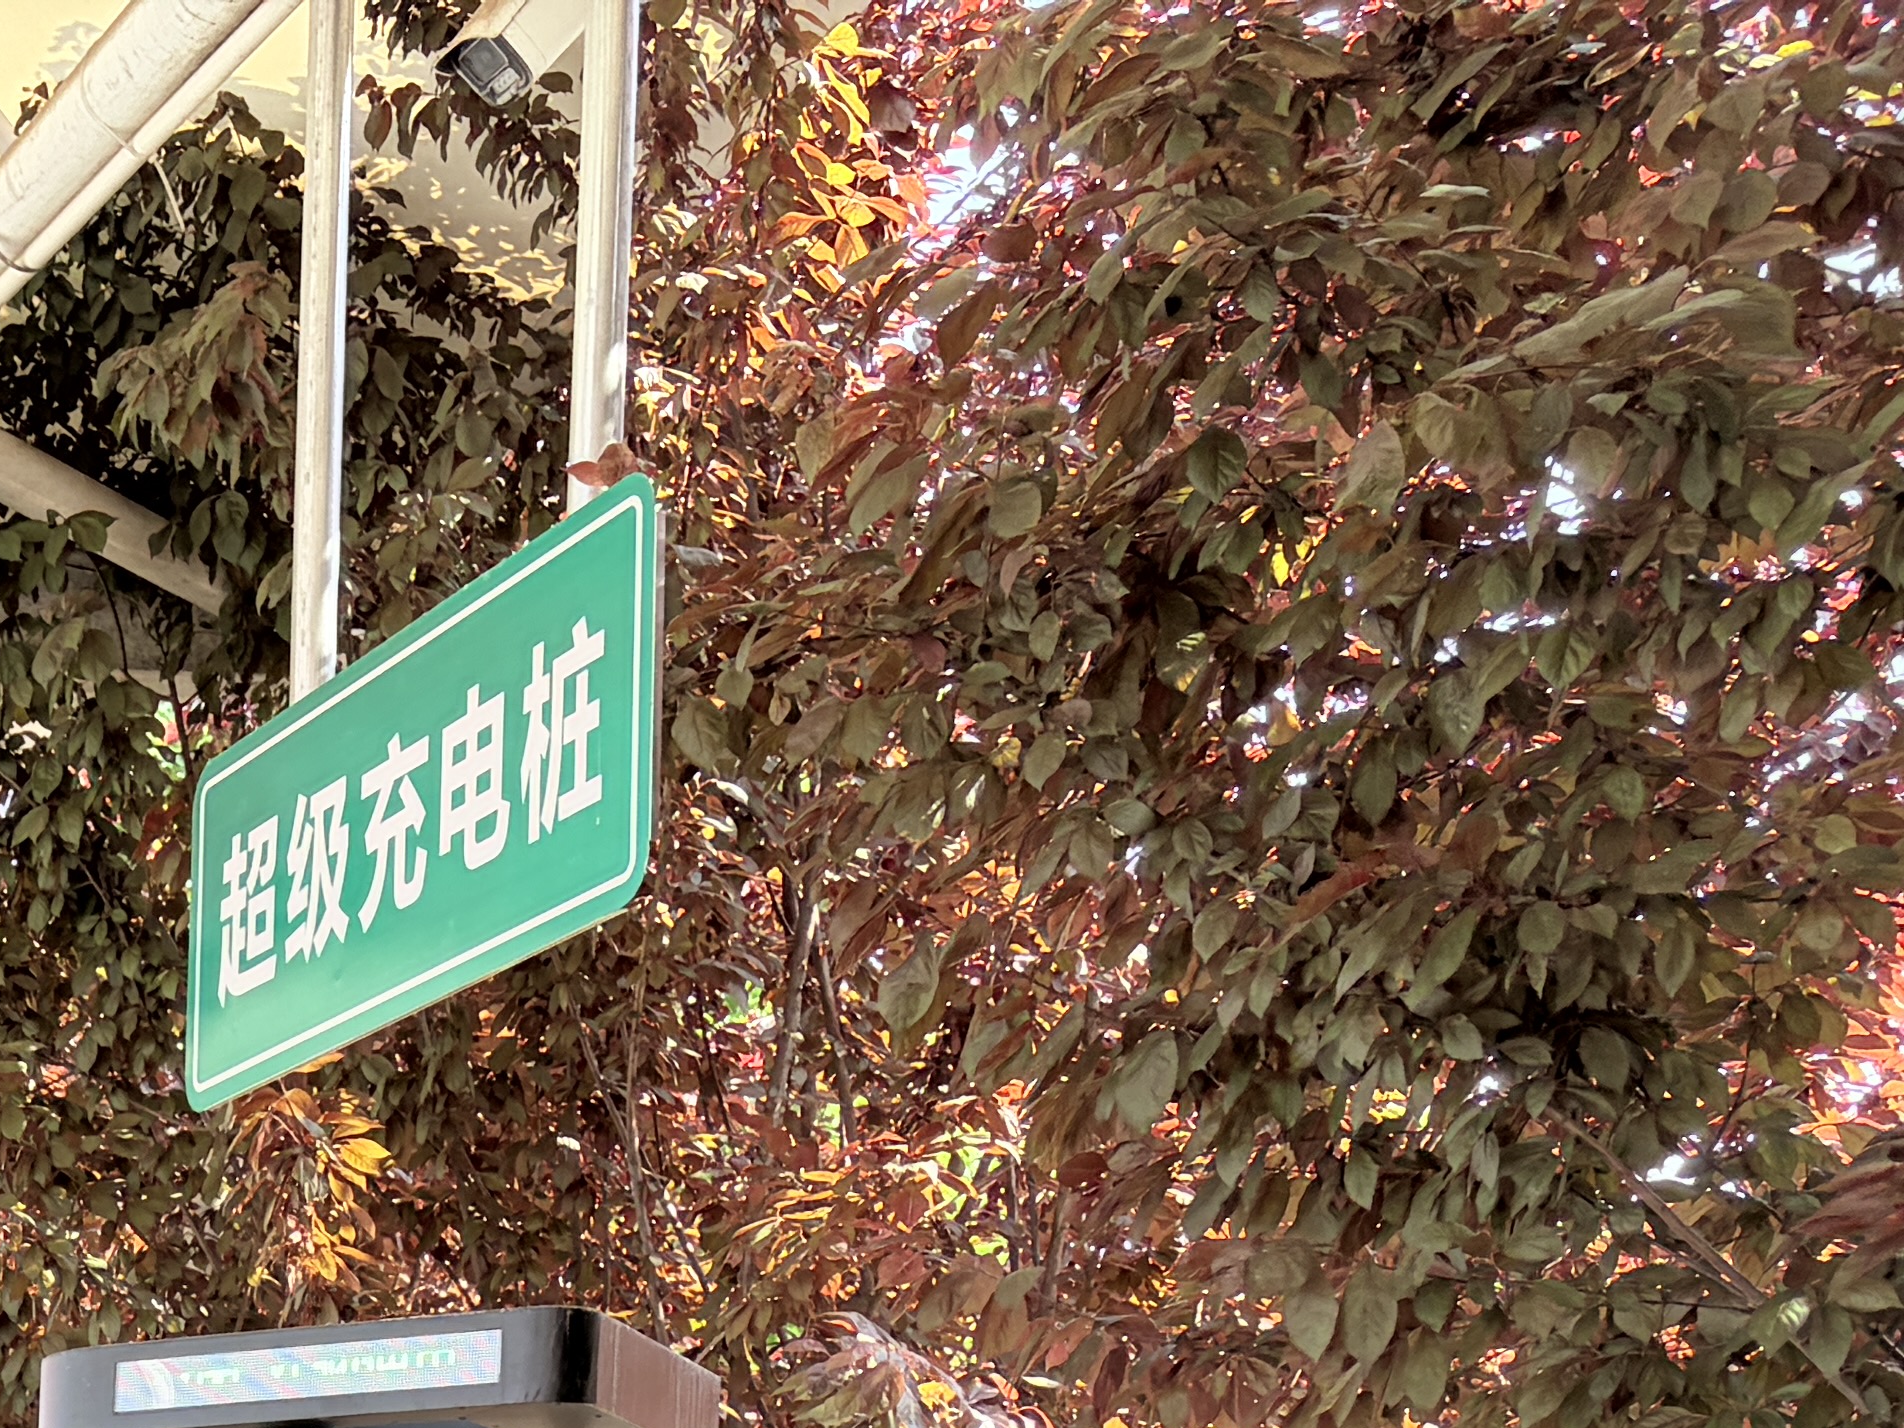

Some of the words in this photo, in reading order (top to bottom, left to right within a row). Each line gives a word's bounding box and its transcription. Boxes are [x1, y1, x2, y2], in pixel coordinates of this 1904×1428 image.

[218, 615, 605, 1008] 超级充电桩
